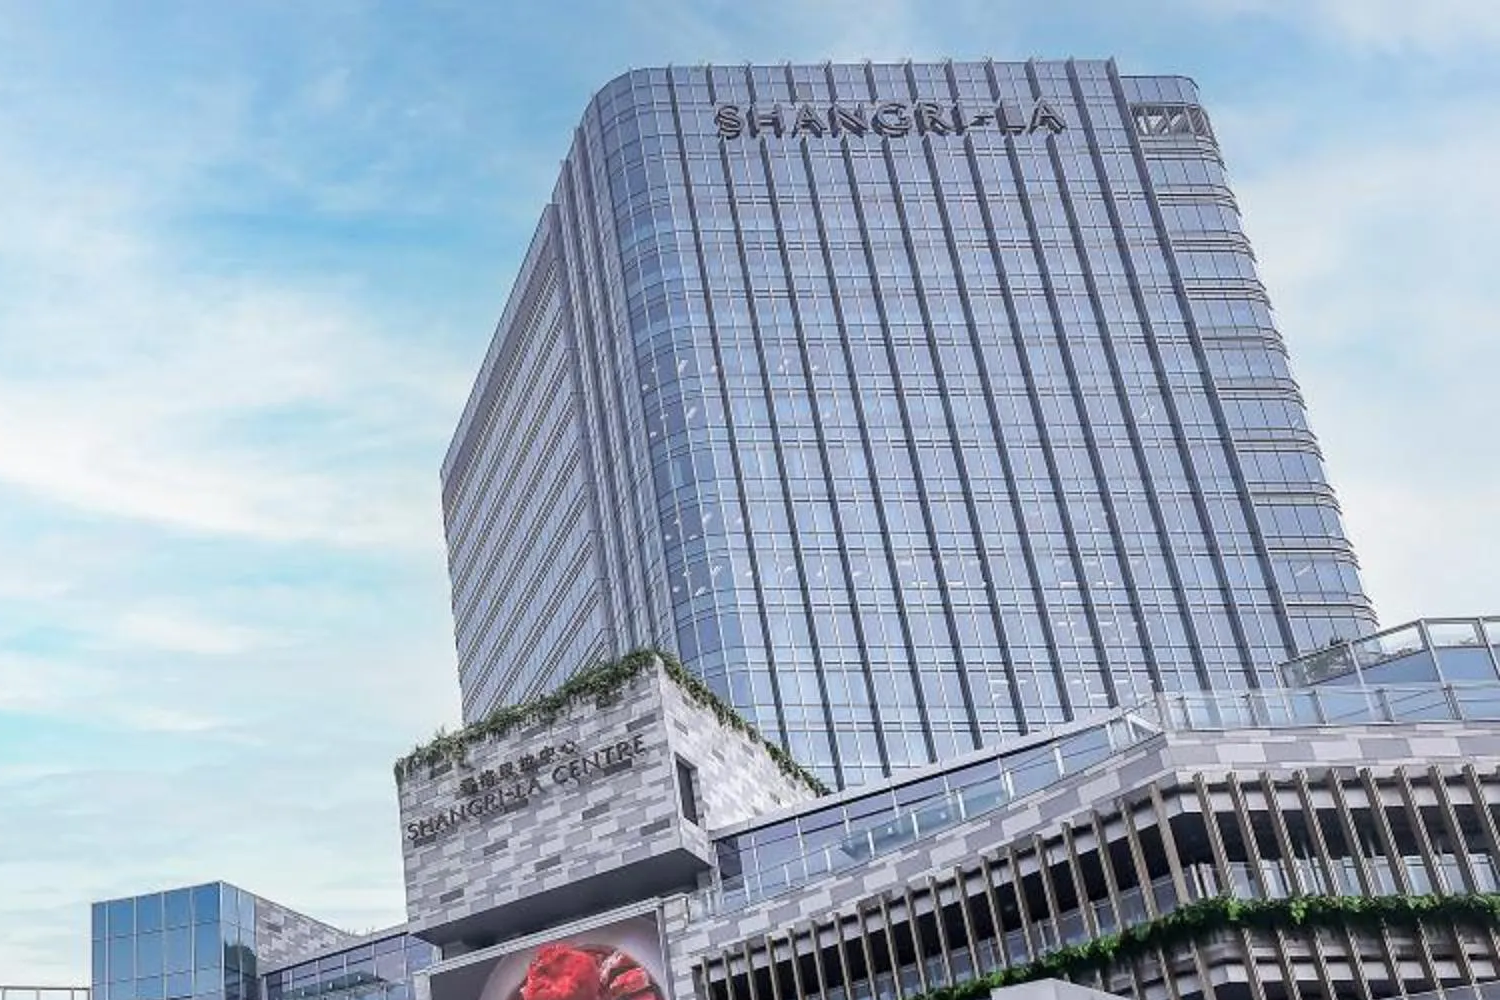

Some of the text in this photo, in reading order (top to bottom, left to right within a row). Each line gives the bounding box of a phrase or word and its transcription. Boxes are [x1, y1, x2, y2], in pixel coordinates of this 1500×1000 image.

[714, 102, 1066, 139] SHANGRI-LA
[406, 734, 648, 841] SHANGRI-LA CENTRE
